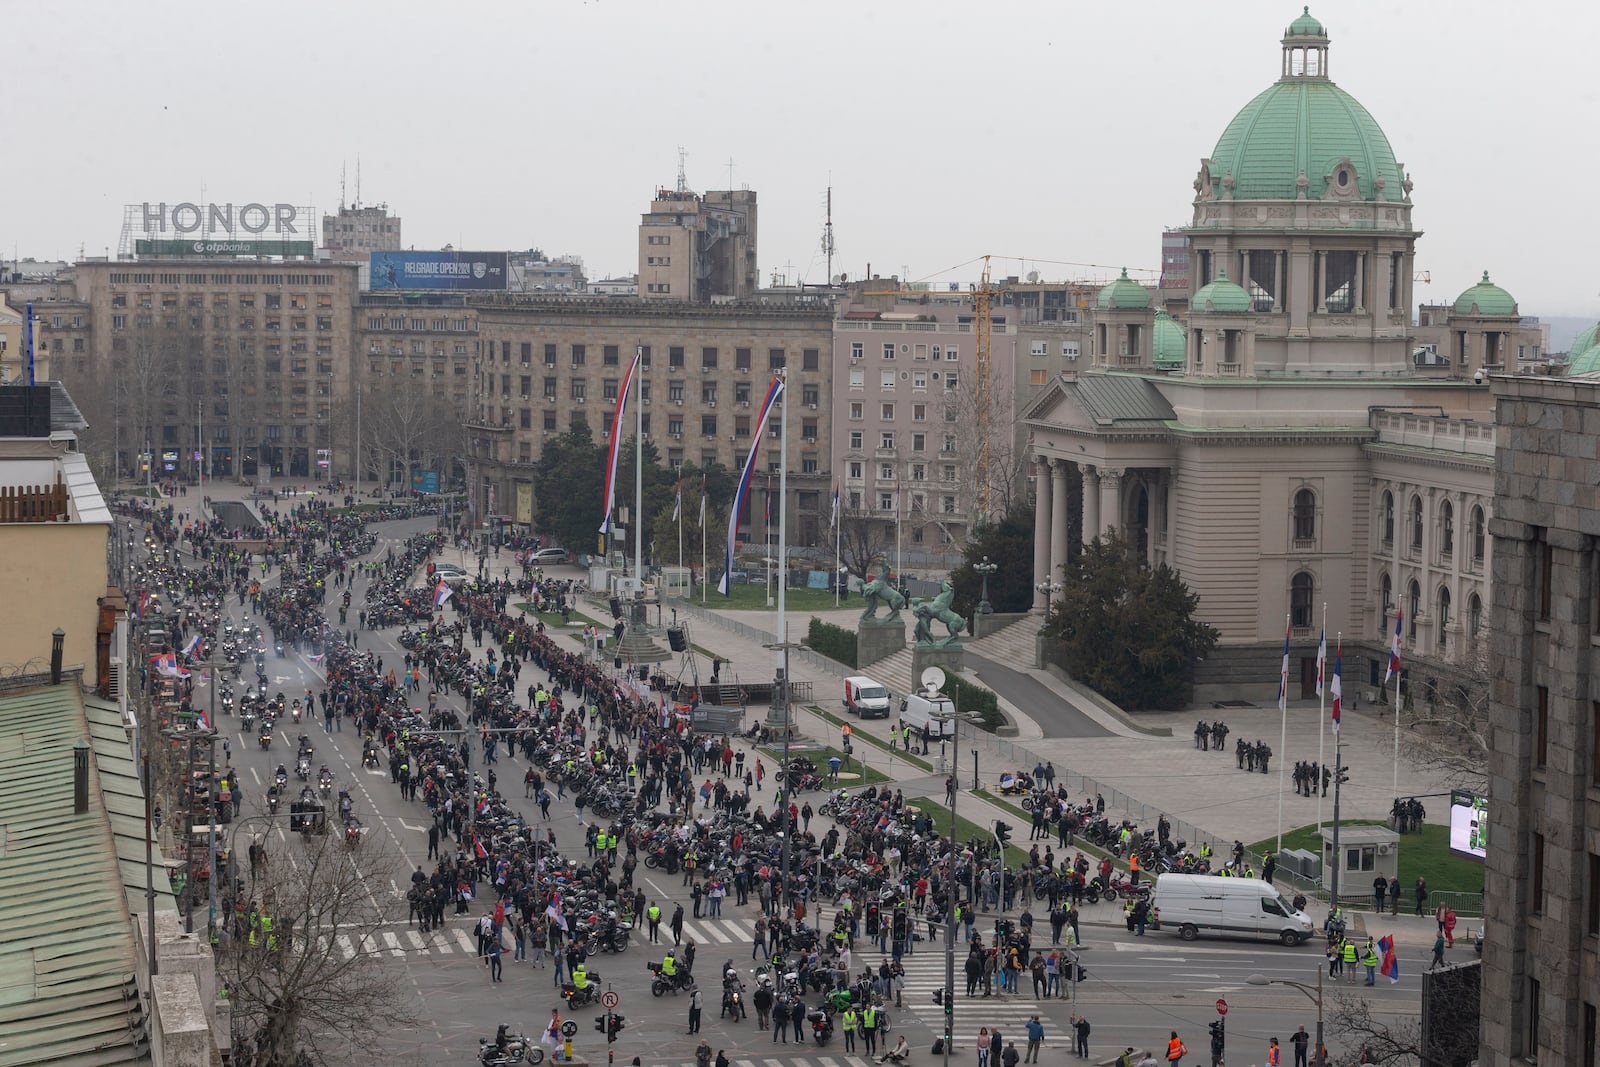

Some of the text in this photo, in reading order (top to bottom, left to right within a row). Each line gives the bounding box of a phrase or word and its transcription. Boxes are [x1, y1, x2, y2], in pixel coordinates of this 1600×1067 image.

[142, 202, 298, 233] HONOR
[206, 241, 250, 253] otpbanka
[404, 262, 439, 274] BELGRADE
[439, 262, 458, 274] OPEN
[1216, 1003, 1227, 1011] STOP
